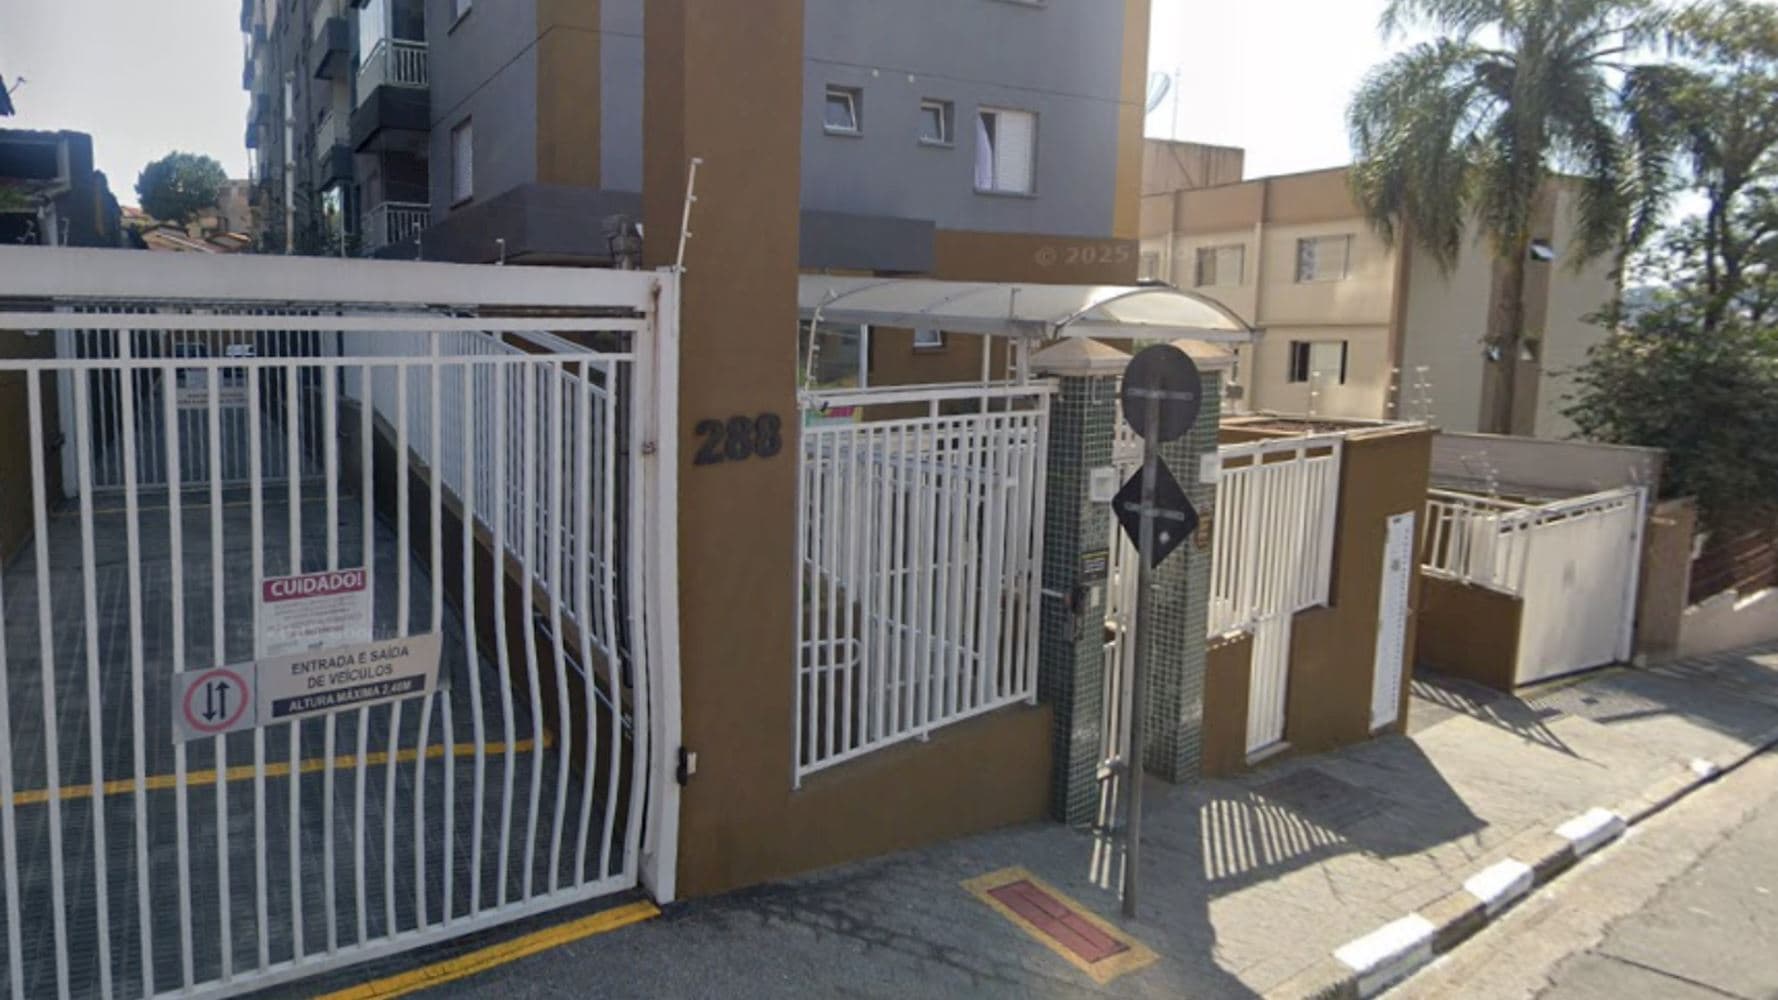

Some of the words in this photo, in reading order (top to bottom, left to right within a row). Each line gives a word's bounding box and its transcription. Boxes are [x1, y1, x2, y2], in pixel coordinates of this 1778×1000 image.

[693, 413, 783, 465] 288
[270, 573, 362, 597] CUIDADO!
[291, 654, 355, 675] ENTRADA
[358, 651, 368, 664] E
[370, 644, 409, 662] SAÍDA
[307, 675, 326, 689] DE
[328, 663, 393, 685] VEÍCULOS
[289, 694, 334, 713] ALTURA
